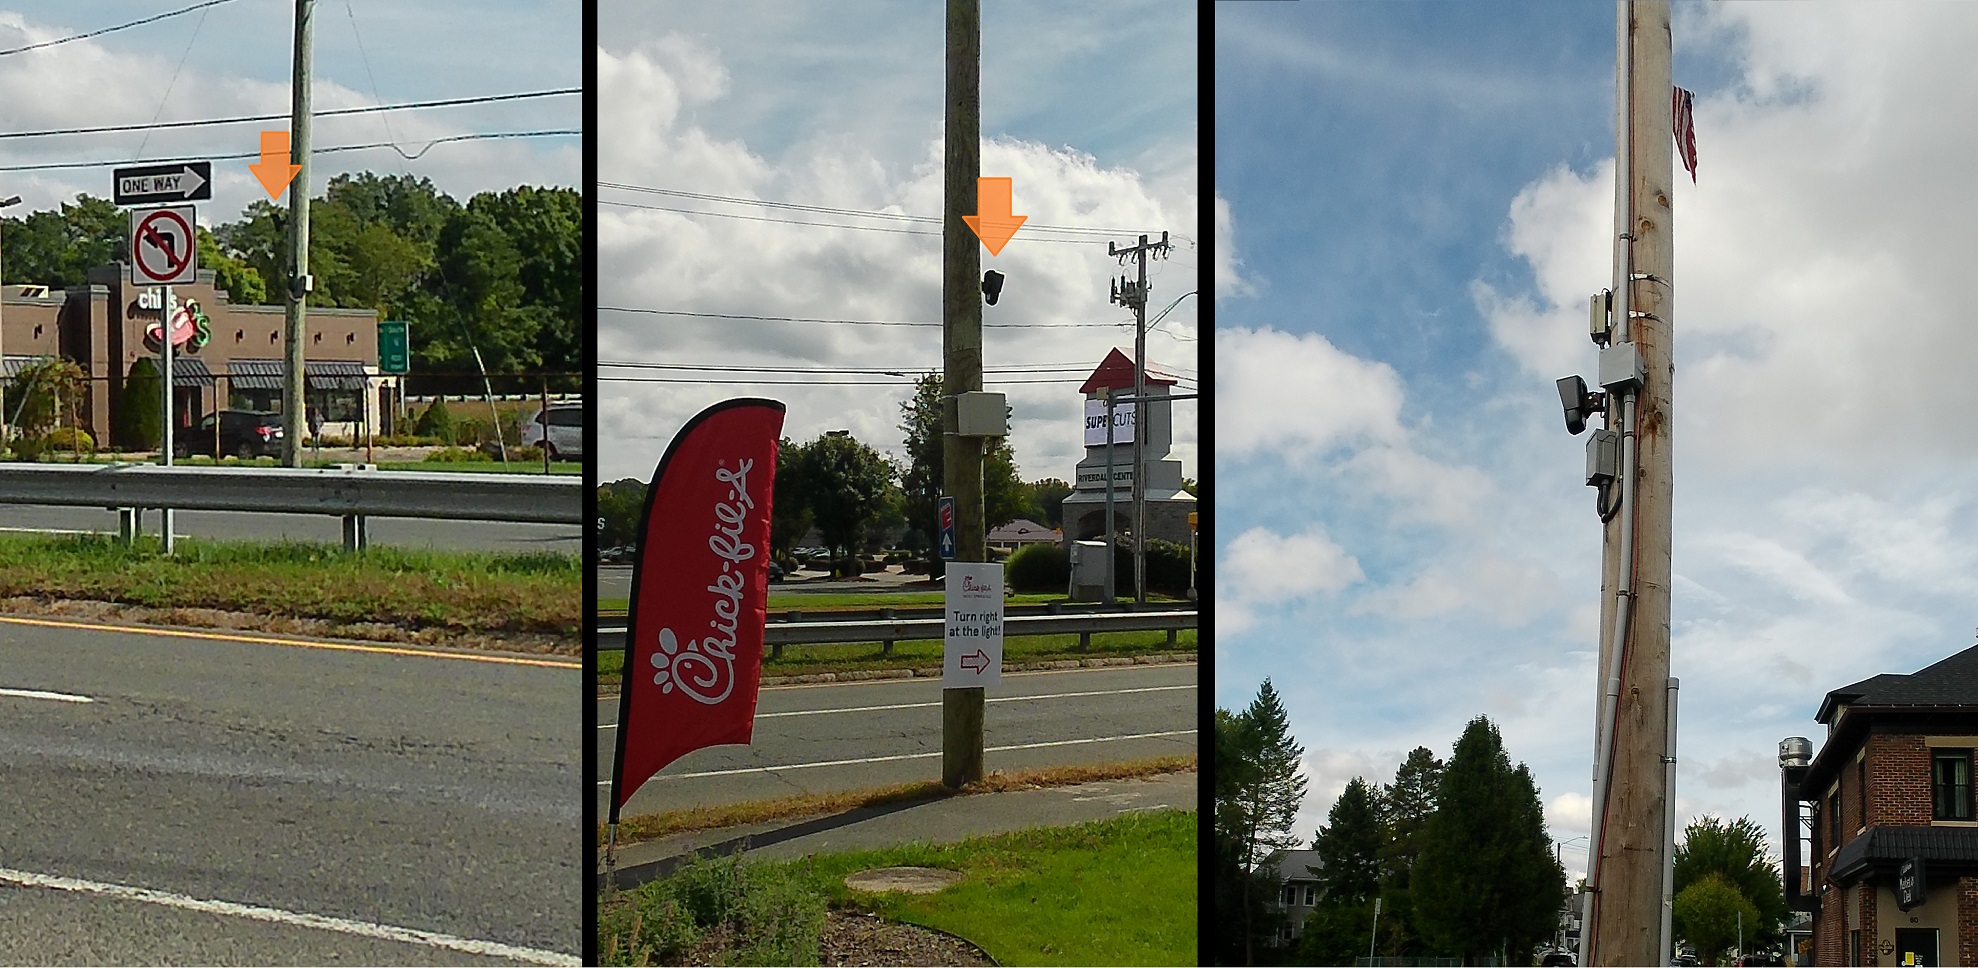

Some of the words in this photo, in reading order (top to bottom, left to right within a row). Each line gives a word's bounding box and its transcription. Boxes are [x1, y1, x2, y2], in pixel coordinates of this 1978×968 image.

[123, 179, 149, 193] ONE
[153, 176, 182, 191] WAY
[1085, 411, 1135, 429] SUPECUTS
[1078, 472, 1107, 483] RIVERDAL
[1113, 471, 1134, 481] CENTE
[953, 610, 977, 622] Turn
[979, 610, 998, 624] right
[949, 625, 960, 637] at
[962, 625, 979, 637] the
[981, 625, 1001, 639] light!
